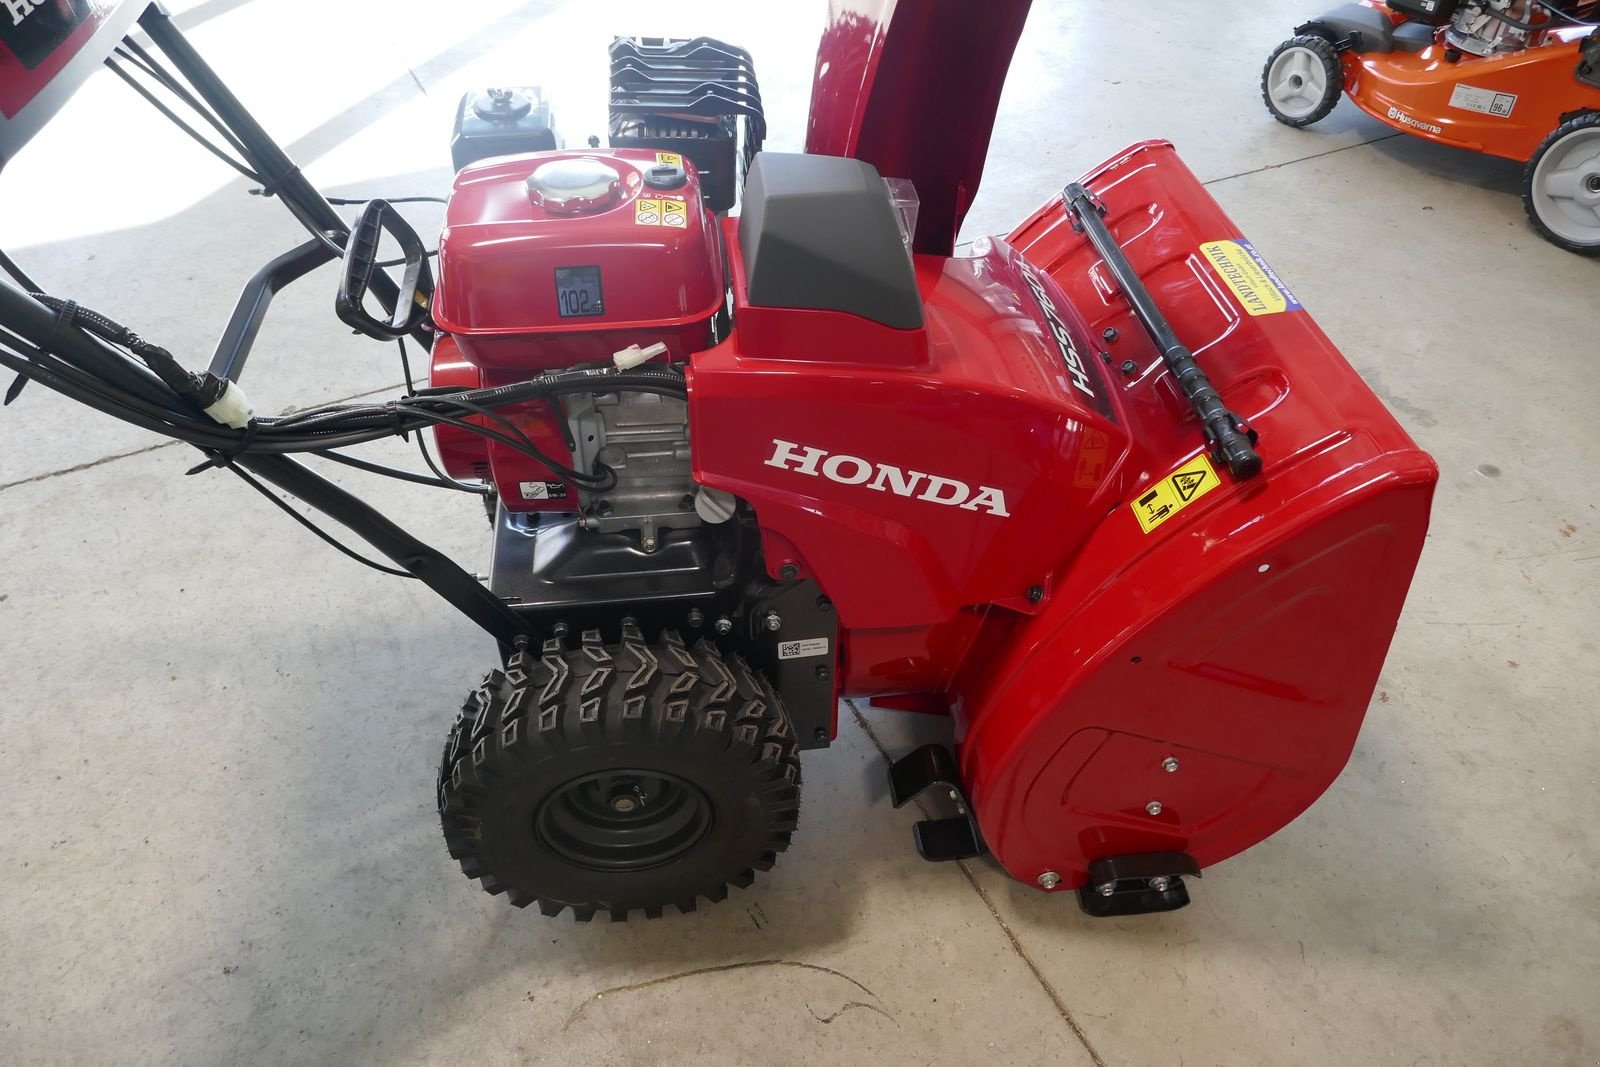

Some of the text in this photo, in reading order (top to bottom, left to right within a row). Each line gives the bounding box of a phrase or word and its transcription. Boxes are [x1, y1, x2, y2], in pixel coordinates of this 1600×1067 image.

[1493, 103, 1503, 112] 96
[1396, 112, 1441, 134] Husqvarna
[1206, 245, 1267, 311] LANDTECHNIK
[560, 289, 591, 314] 102
[764, 438, 1011, 517] HONDA
